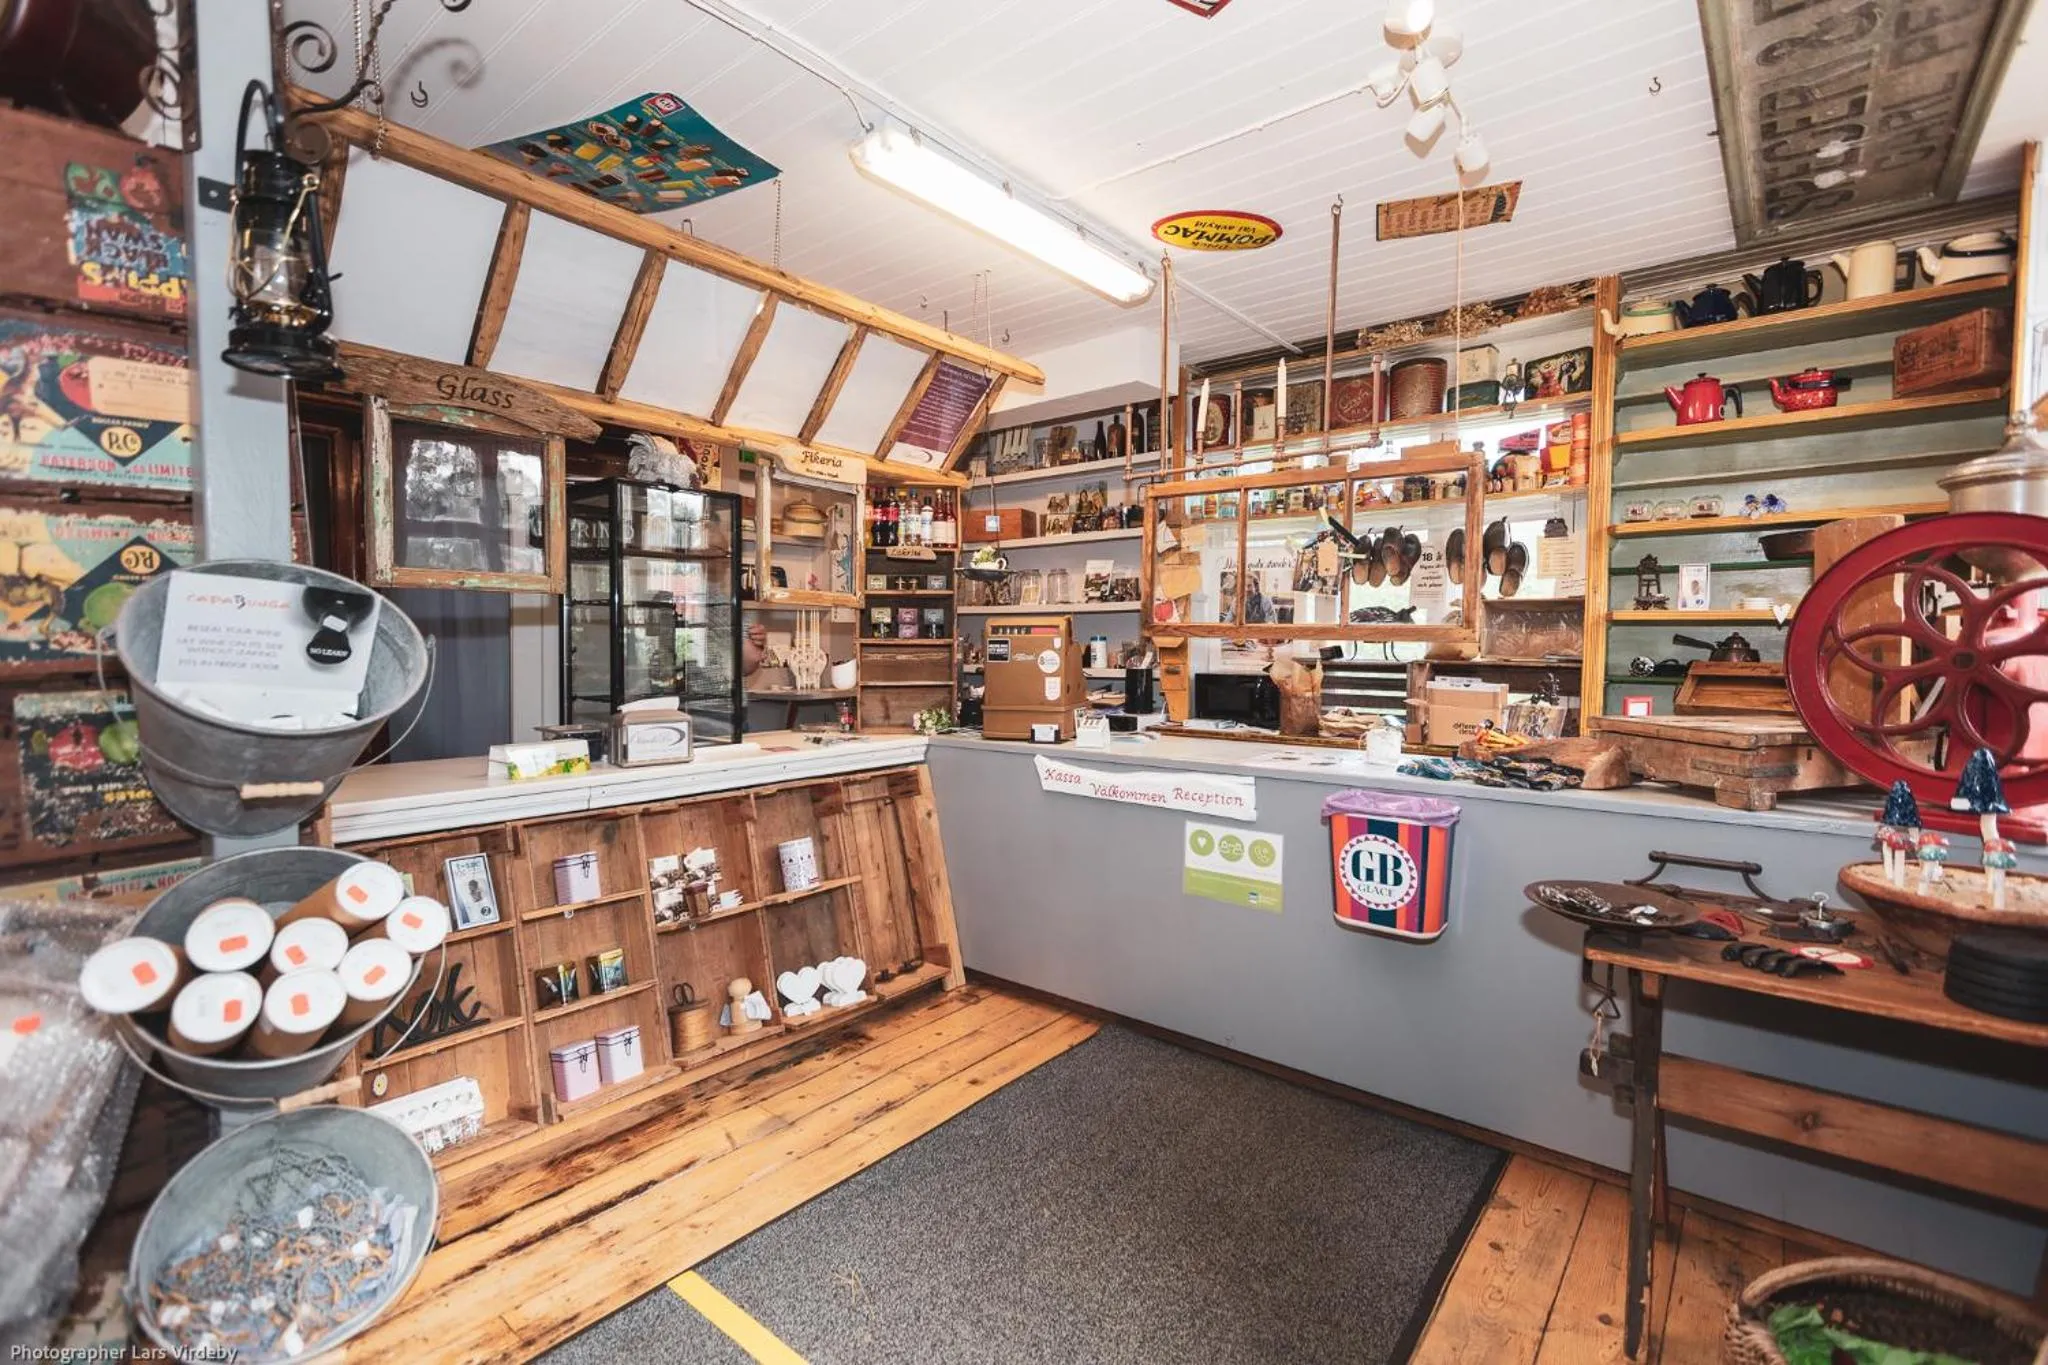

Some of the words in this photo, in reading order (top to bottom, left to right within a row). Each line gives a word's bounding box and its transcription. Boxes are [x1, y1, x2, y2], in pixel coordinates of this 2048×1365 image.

[436, 373, 516, 410] Glass
[1043, 768, 1082, 786] Kassa
[1089, 782, 1167, 804] Välkommen
[1172, 787, 1244, 807] Reception
[1351, 849, 1403, 887] GB
